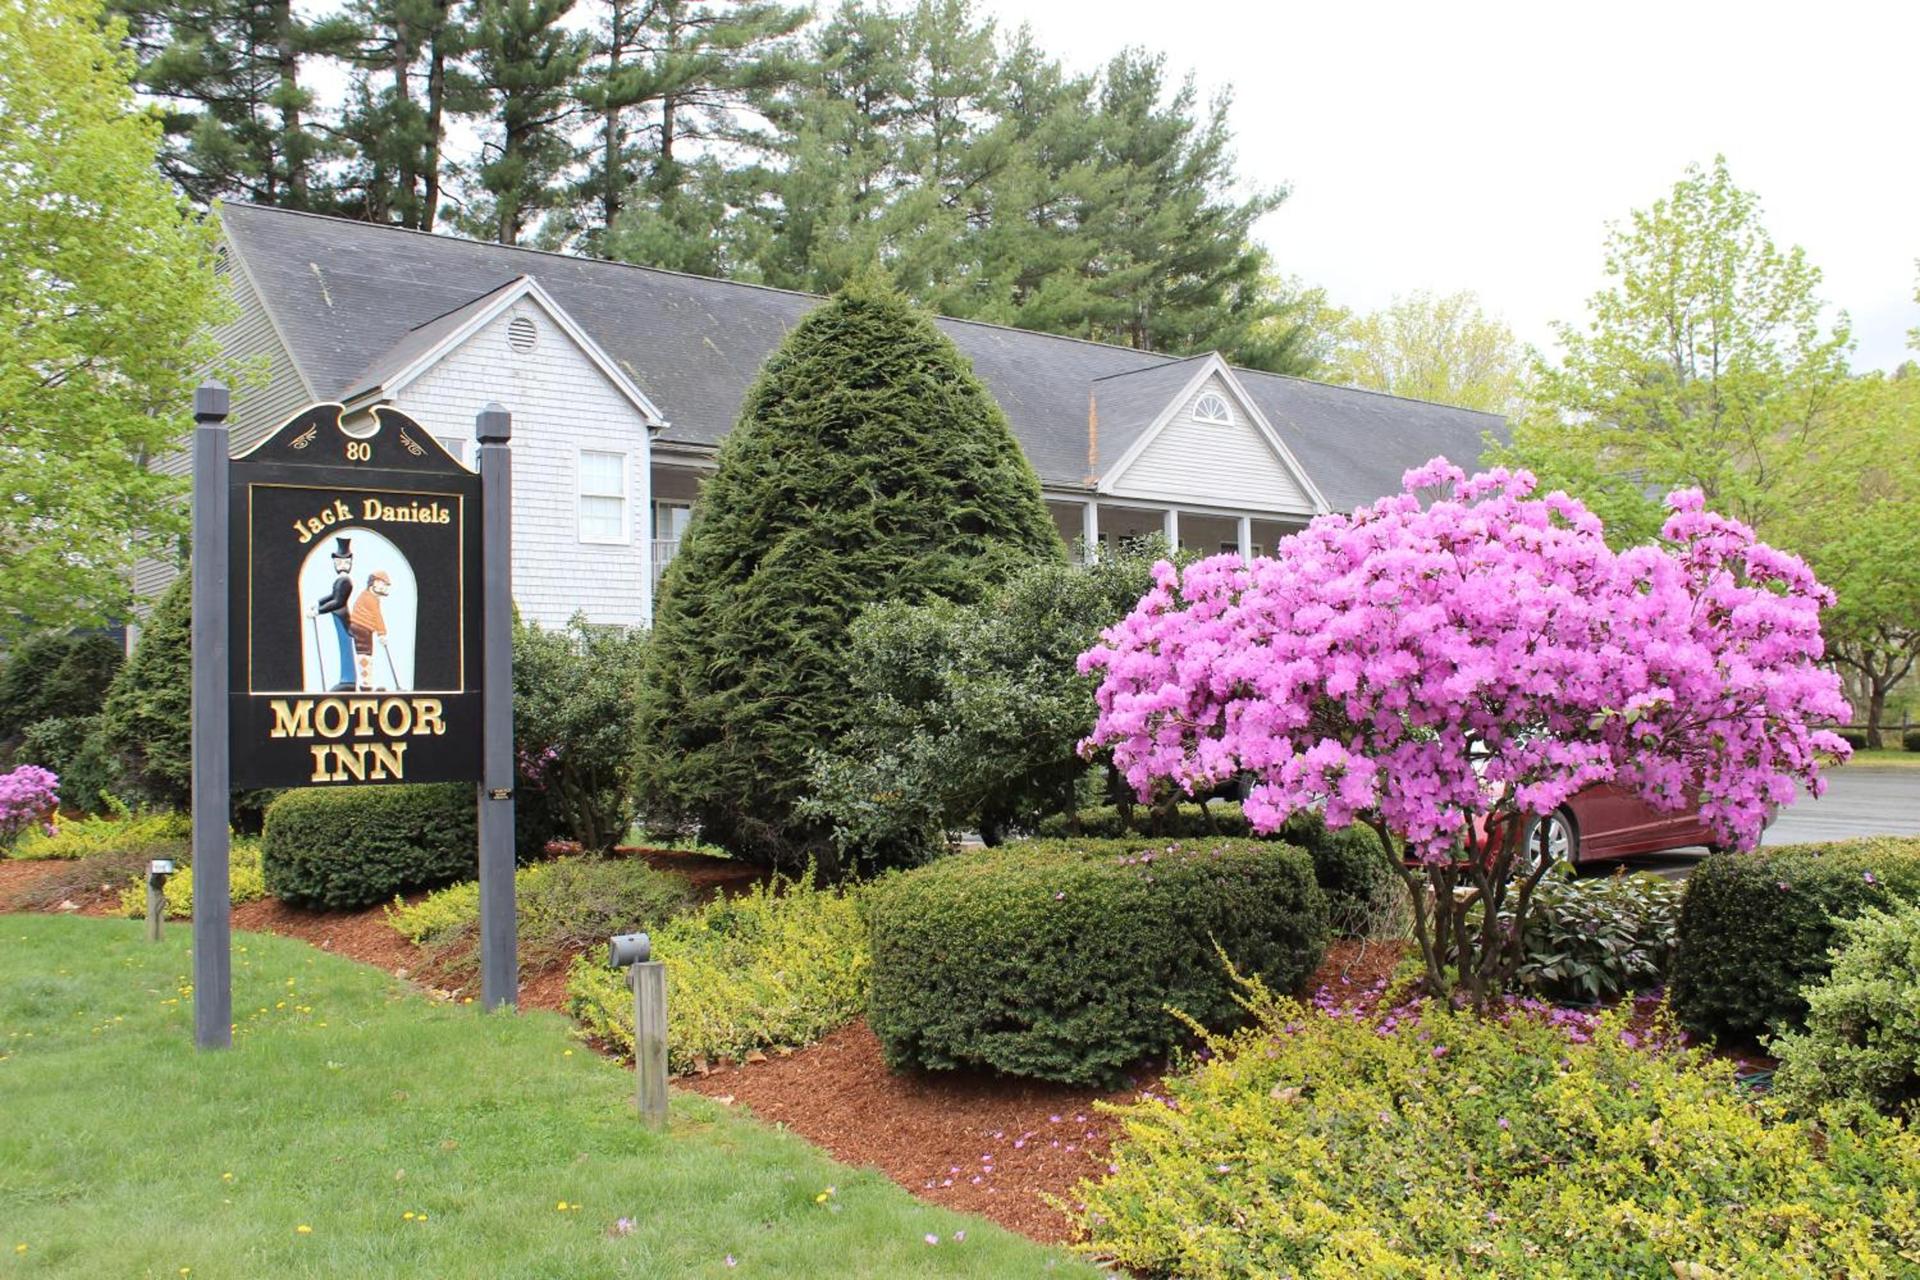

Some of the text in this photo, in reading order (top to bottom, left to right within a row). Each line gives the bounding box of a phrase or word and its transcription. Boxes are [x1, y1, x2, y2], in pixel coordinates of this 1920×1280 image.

[346, 442, 371, 461] 80
[293, 499, 450, 543] Jack Daniels
[270, 697, 446, 738] MOTOR
[310, 742, 407, 782] INN
